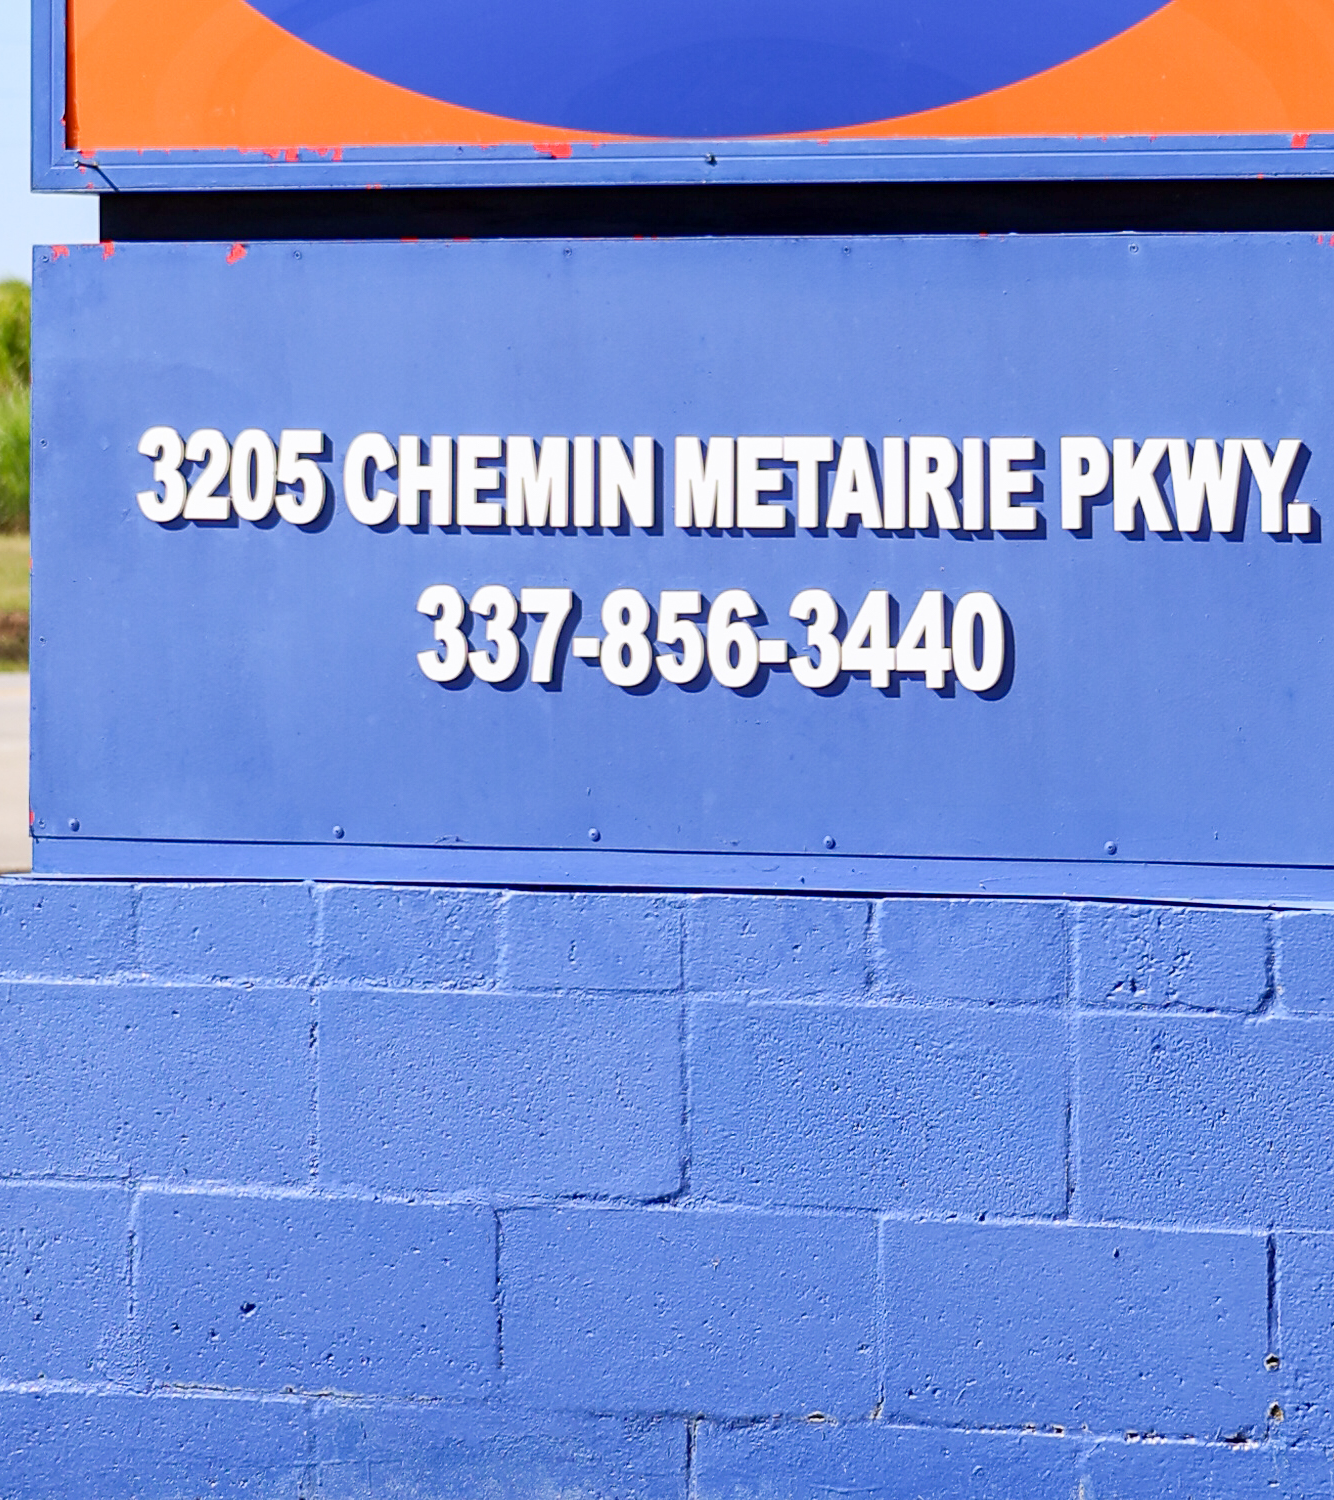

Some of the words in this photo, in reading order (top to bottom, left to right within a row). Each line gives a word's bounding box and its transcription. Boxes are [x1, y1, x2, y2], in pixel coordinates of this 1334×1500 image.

[136, 426, 325, 525] 3205
[342, 431, 654, 528] CHEMIN
[673, 436, 1037, 531] METAIRIE
[1059, 436, 1310, 535] PKWY.
[416, 583, 1004, 691] 337-856-3440
